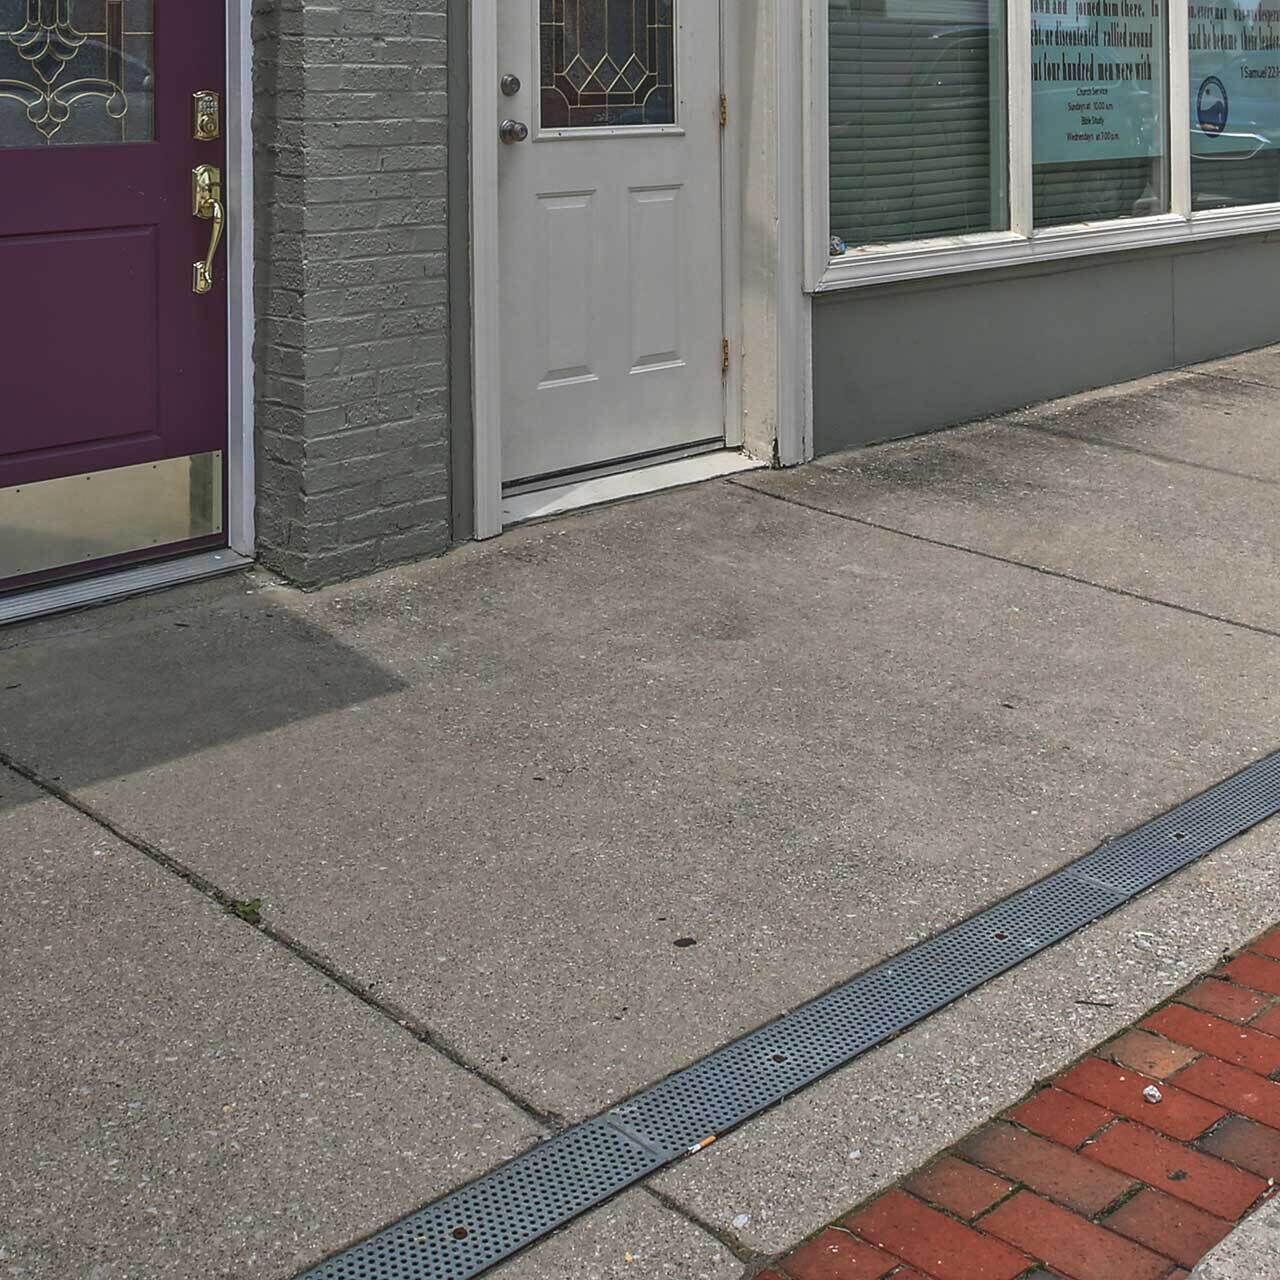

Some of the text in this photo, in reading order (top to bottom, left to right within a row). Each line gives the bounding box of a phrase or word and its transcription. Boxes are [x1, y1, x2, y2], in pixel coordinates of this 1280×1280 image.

[1045, 29, 1053, 46] or
[1054, 20, 1099, 47] discontented
[1103, 21, 1127, 48] rallied
[1128, 23, 1153, 48] around
[1212, 23, 1238, 51] became
[1043, 51, 1060, 81] four
[1062, 52, 1094, 81] hundred
[1097, 62, 1114, 81] men
[1115, 62, 1134, 81] were
[1135, 53, 1152, 81] with
[1244, 64, 1266, 79] Samuel
